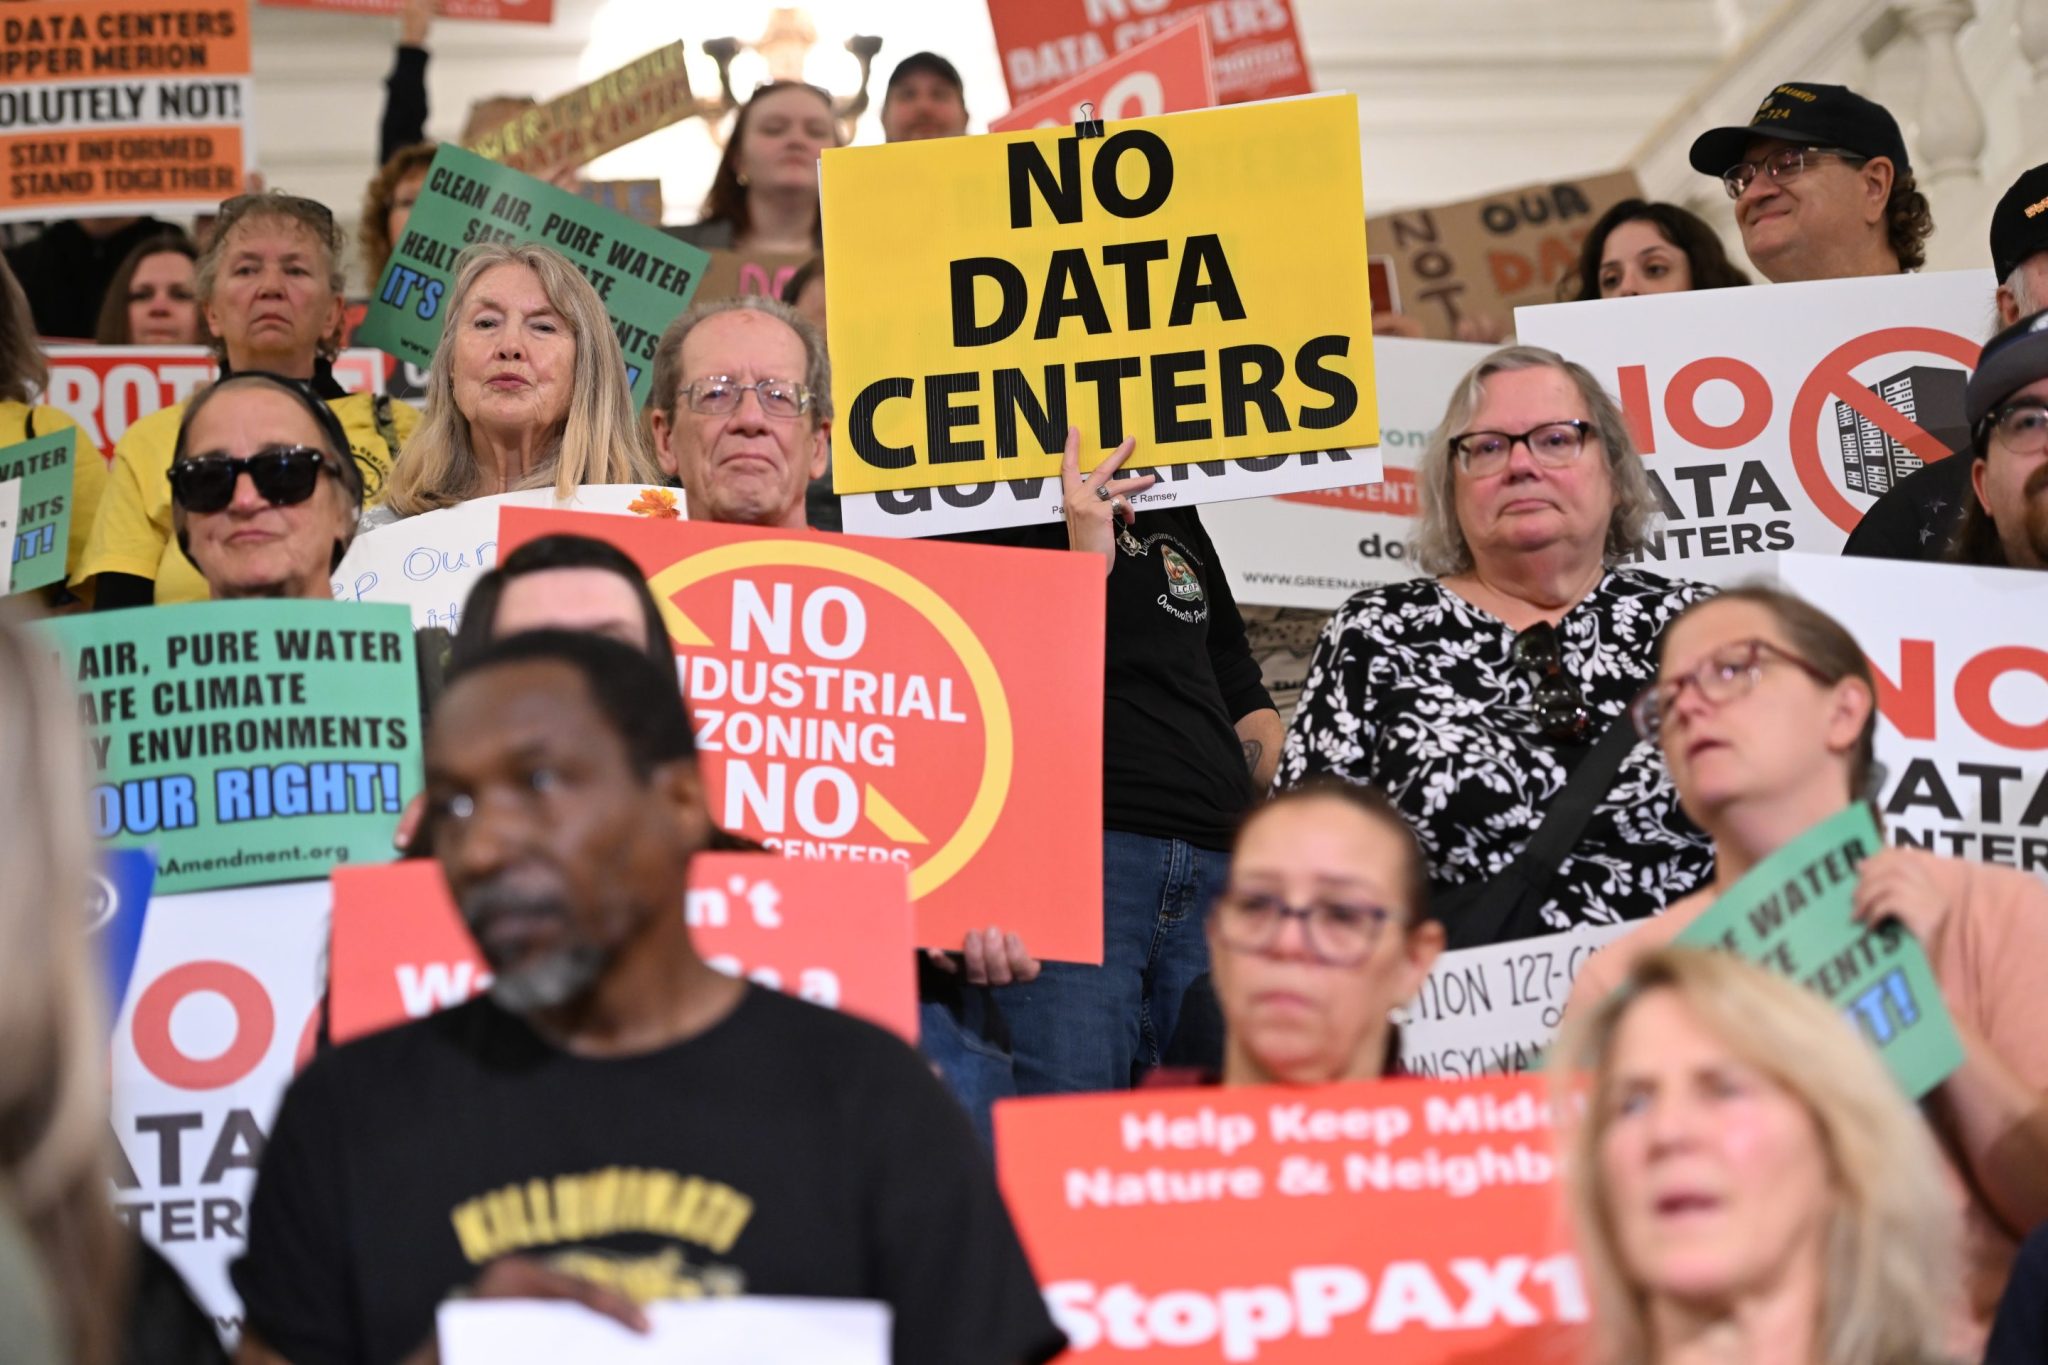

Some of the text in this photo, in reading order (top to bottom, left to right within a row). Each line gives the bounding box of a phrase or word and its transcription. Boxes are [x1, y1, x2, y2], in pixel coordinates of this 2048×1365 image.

[5, 10, 235, 44] DATA CENTERS
[92, 45, 207, 71] MERION
[1007, 32, 1108, 89] DATA
[159, 83, 243, 121] NOT!
[10, 138, 214, 167] STAY INFORMED
[10, 167, 236, 198] STAND TOGETHER
[1007, 129, 1175, 230] NO
[429, 167, 491, 211] CLEAN
[491, 192, 533, 232] AIR,
[541, 213, 604, 257] PURE
[606, 240, 691, 297] WATER
[1481, 182, 1589, 236] OUR
[401, 230, 458, 275] HEALT
[381, 262, 446, 322] IT'S
[949, 233, 1248, 348] DATA
[49, 363, 222, 450] ROT
[848, 334, 1359, 470] CENTERS
[1130, 495, 1137, 504] E
[1140, 492, 1178, 504] Ramsey
[1603, 519, 1795, 565] NTERS
[730, 579, 867, 660] NO
[167, 630, 259, 669] PURE
[275, 629, 402, 664] WATER
[152, 672, 306, 717] CLIMATE
[128, 715, 409, 766] ENVIRONMENTS
[694, 709, 896, 767] ZONING
[214, 760, 401, 824] RIGHT!
[723, 759, 859, 839] NO
[1747, 836, 1869, 941] WATER
[1121, 1112, 1256, 1154] Help
[1269, 1104, 1410, 1146] Keep
[1064, 1166, 1263, 1208] Nature
[1277, 1156, 1333, 1196] &
